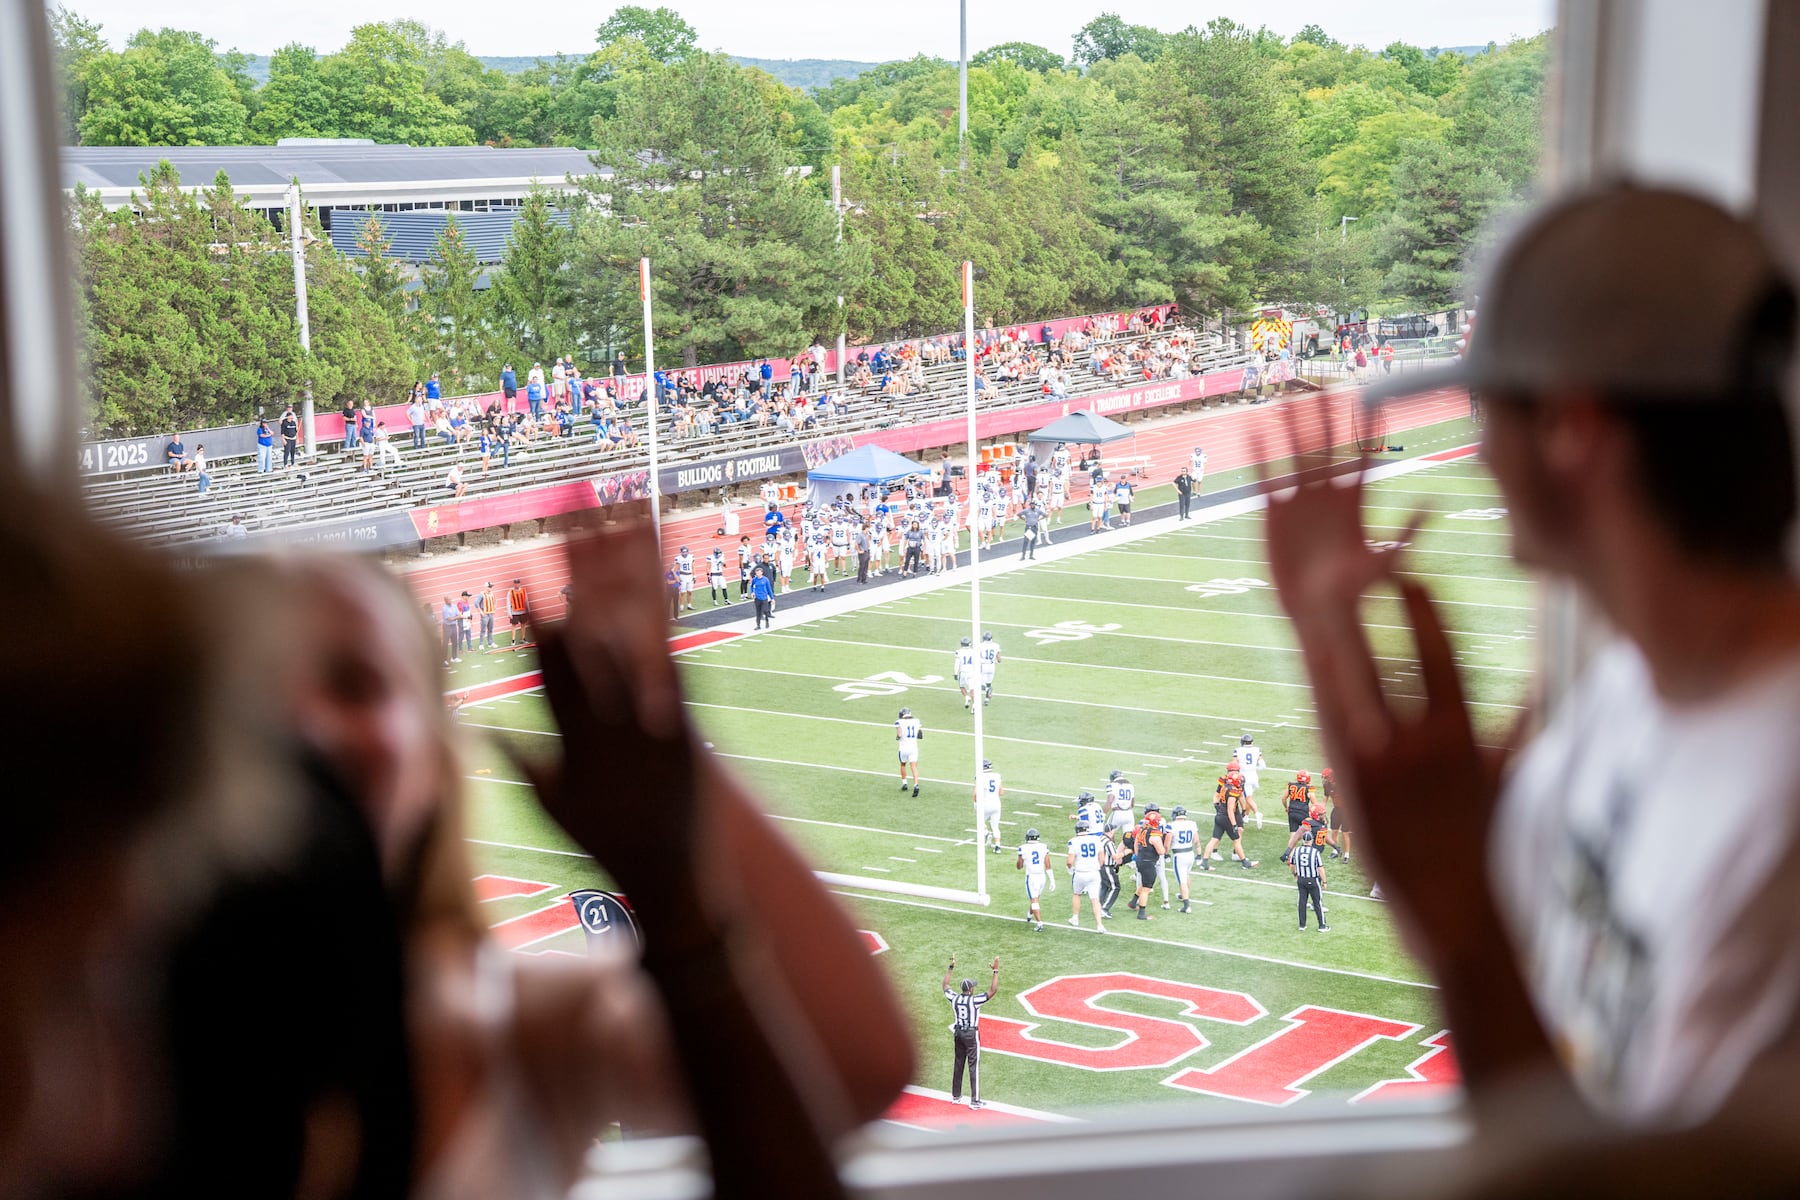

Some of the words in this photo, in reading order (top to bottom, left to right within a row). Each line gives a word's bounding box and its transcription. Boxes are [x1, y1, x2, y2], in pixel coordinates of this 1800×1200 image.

[1097, 393, 1131, 413] TRADITION
[1133, 391, 1142, 406] OF
[1144, 384, 1181, 404] EXCELLENCE
[107, 443, 148, 467] 2025
[678, 464, 722, 487] BULLDOG
[737, 454, 781, 477] FOOTBALL
[985, 649, 995, 660] 16
[832, 671, 944, 696] 20
[907, 726, 915, 738] 11
[1246, 753, 1252, 764] 9
[989, 780, 996, 792] 5
[1118, 789, 1132, 801] 90
[1289, 785, 1307, 803] 34
[1178, 830, 1193, 844] 50
[1081, 843, 1096, 858] 99
[1032, 851, 1040, 865] 2
